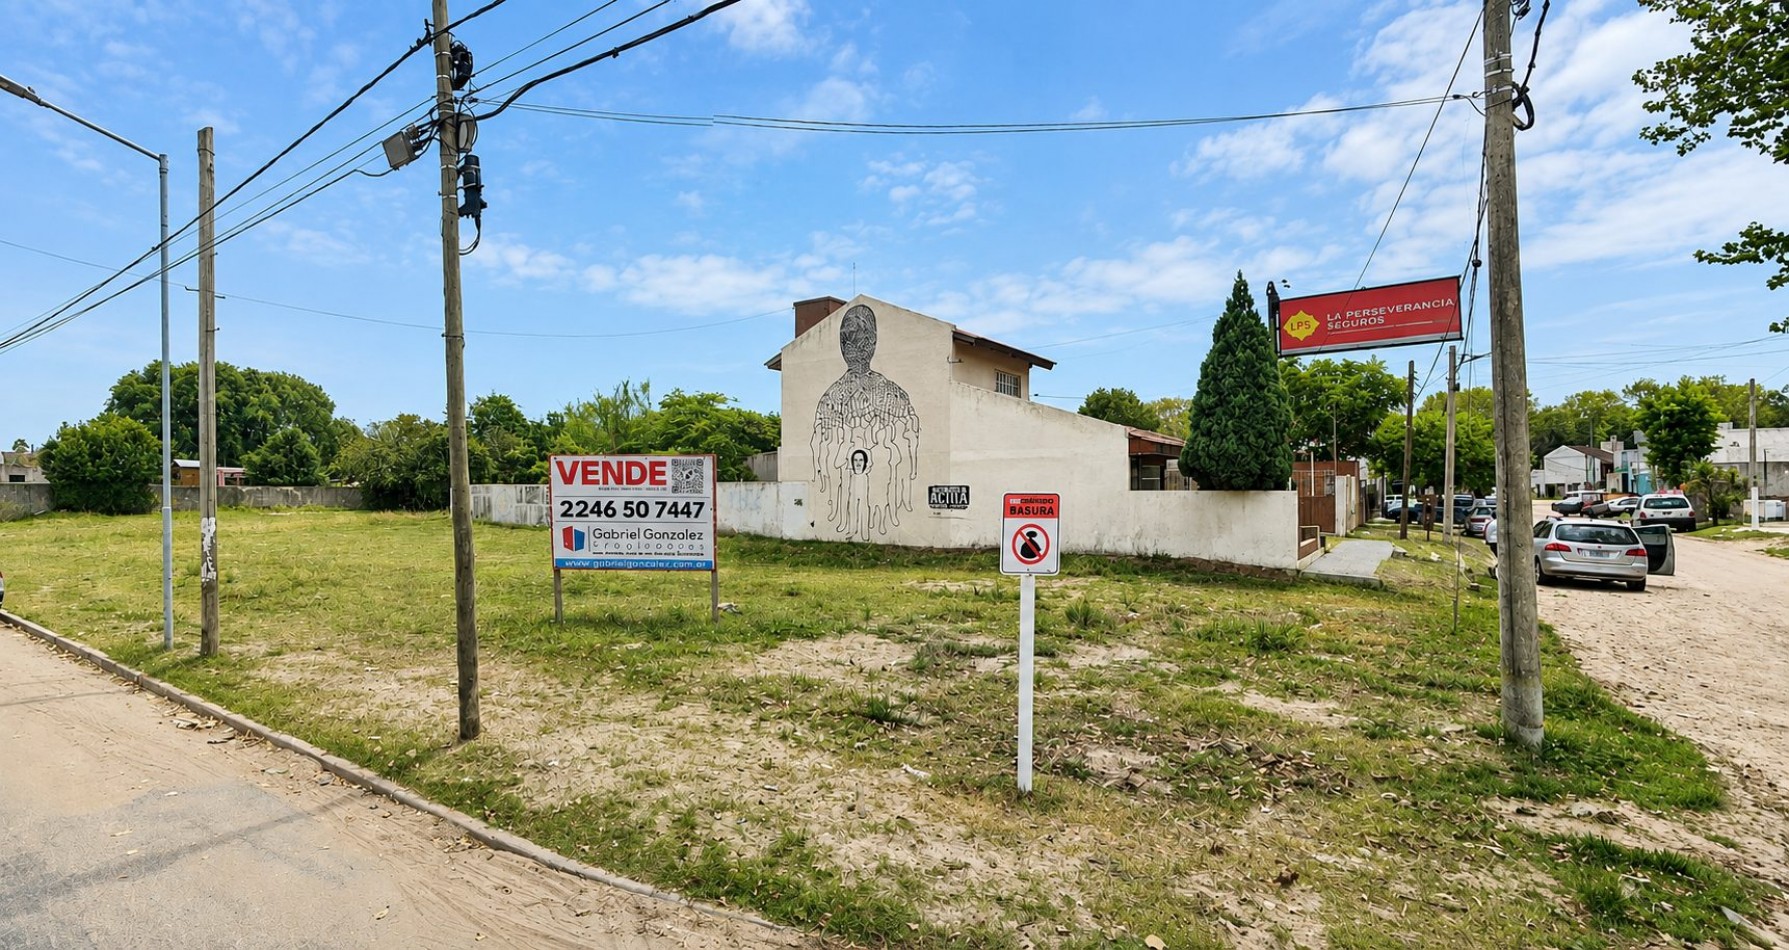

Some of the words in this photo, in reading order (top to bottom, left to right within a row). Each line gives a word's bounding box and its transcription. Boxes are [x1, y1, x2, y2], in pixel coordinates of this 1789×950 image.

[1327, 312, 1342, 321] LA
[1346, 298, 1455, 319] PERSEVERANCIA
[1290, 320, 1311, 332] LPS
[1327, 315, 1385, 330] SEGUROS
[555, 460, 667, 486] VENDE
[559, 500, 617, 518] 2246
[622, 500, 649, 518] 50
[655, 501, 706, 519] 7447
[1009, 505, 1054, 516] BASURA
[592, 527, 640, 540] Gabriel
[643, 528, 704, 541] Gonzalez
